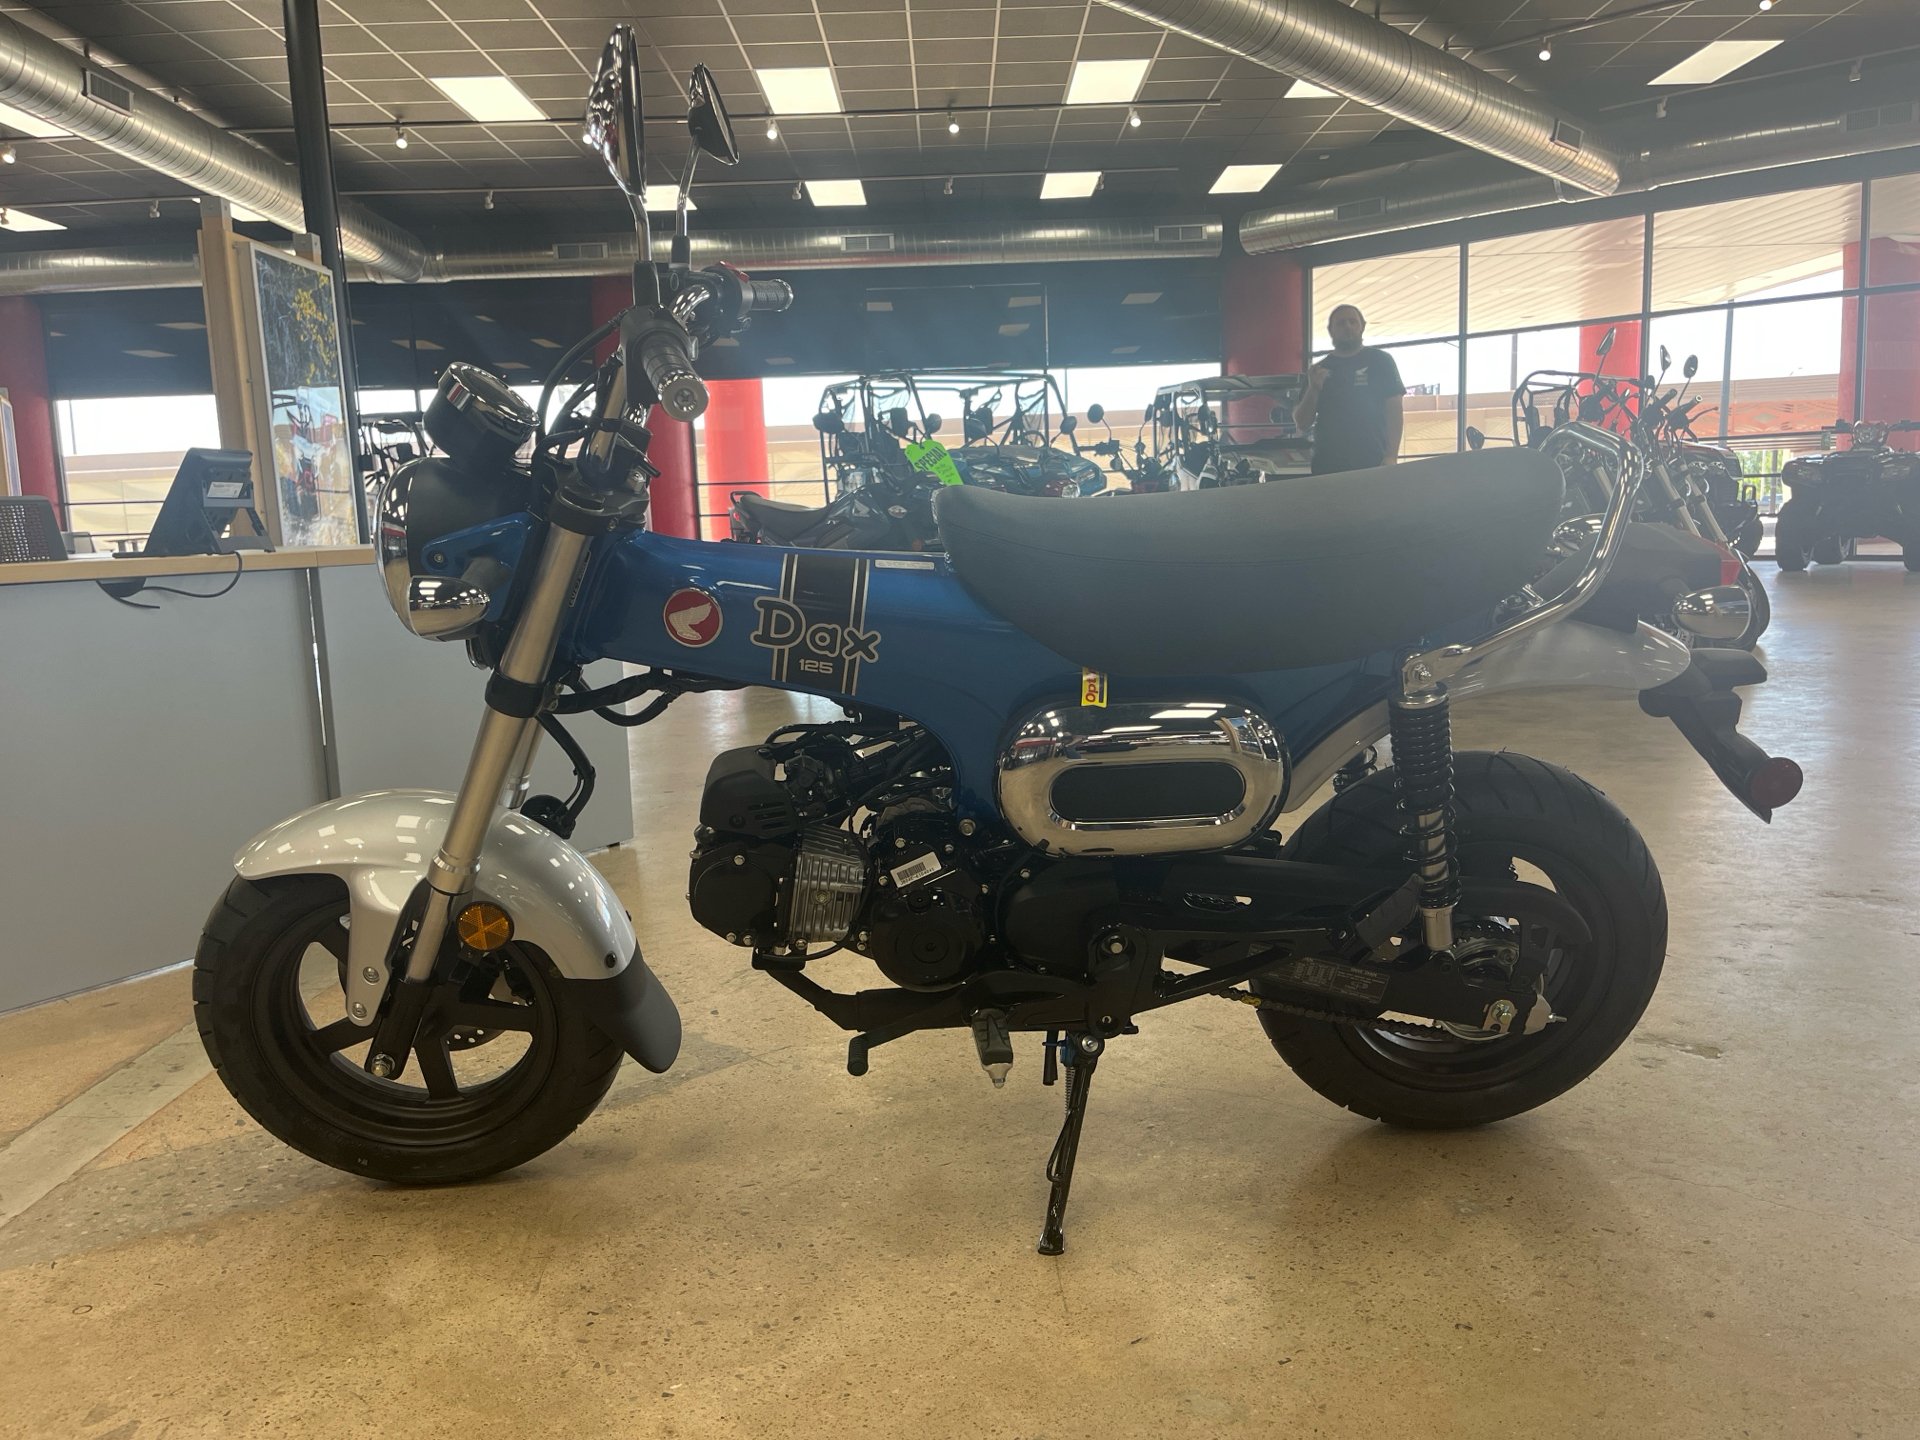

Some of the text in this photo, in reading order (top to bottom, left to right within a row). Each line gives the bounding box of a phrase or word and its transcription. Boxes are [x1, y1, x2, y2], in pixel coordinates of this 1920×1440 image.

[914, 446, 947, 472] SPECIAL
[750, 596, 881, 663] Dax
[799, 658, 833, 674] 125
